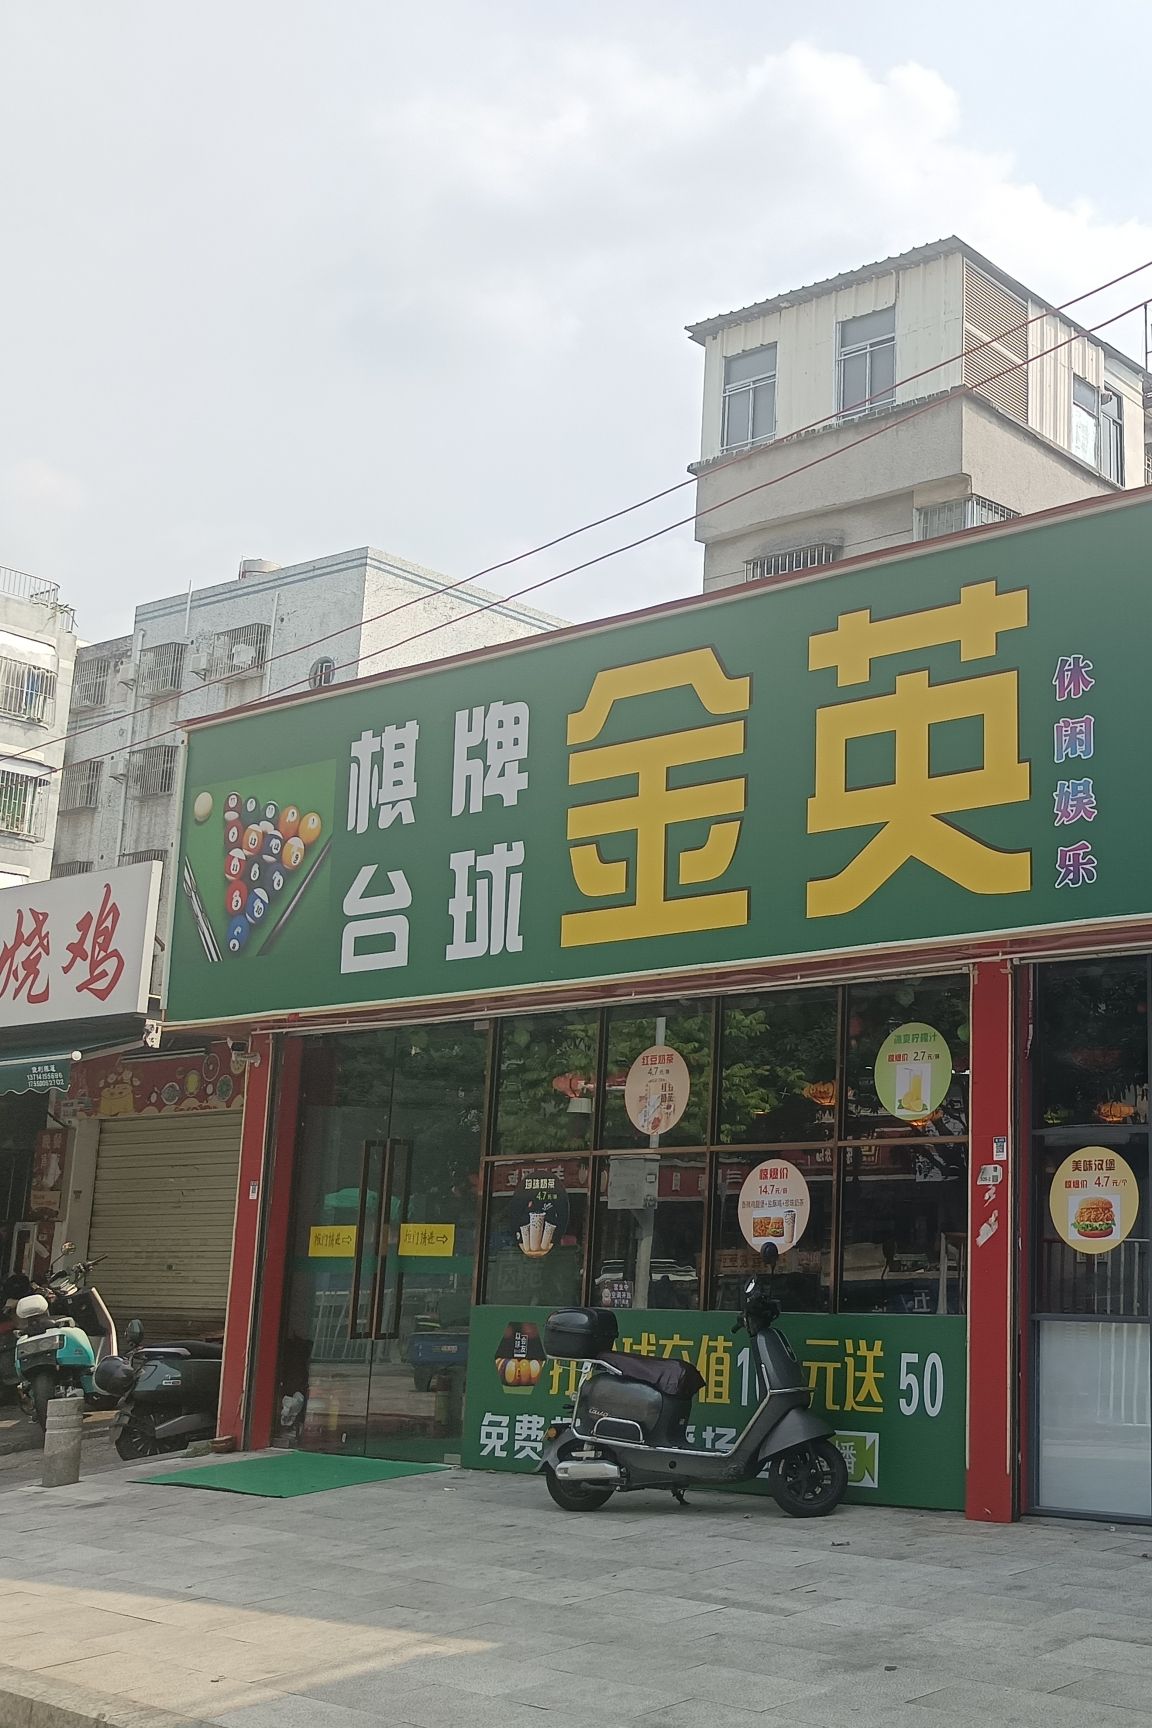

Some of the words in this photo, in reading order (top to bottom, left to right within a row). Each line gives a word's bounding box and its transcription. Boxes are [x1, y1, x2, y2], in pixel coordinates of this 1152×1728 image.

[347, 700, 530, 833] 棋牌
[560, 579, 1031, 947] 金英
[1053, 654, 1097, 888] 休闲娱乐
[0, 883, 125, 1004] 烧鸡
[340, 841, 524, 974] 台球
[1072, 1159, 1115, 1172] 美味汉堡
